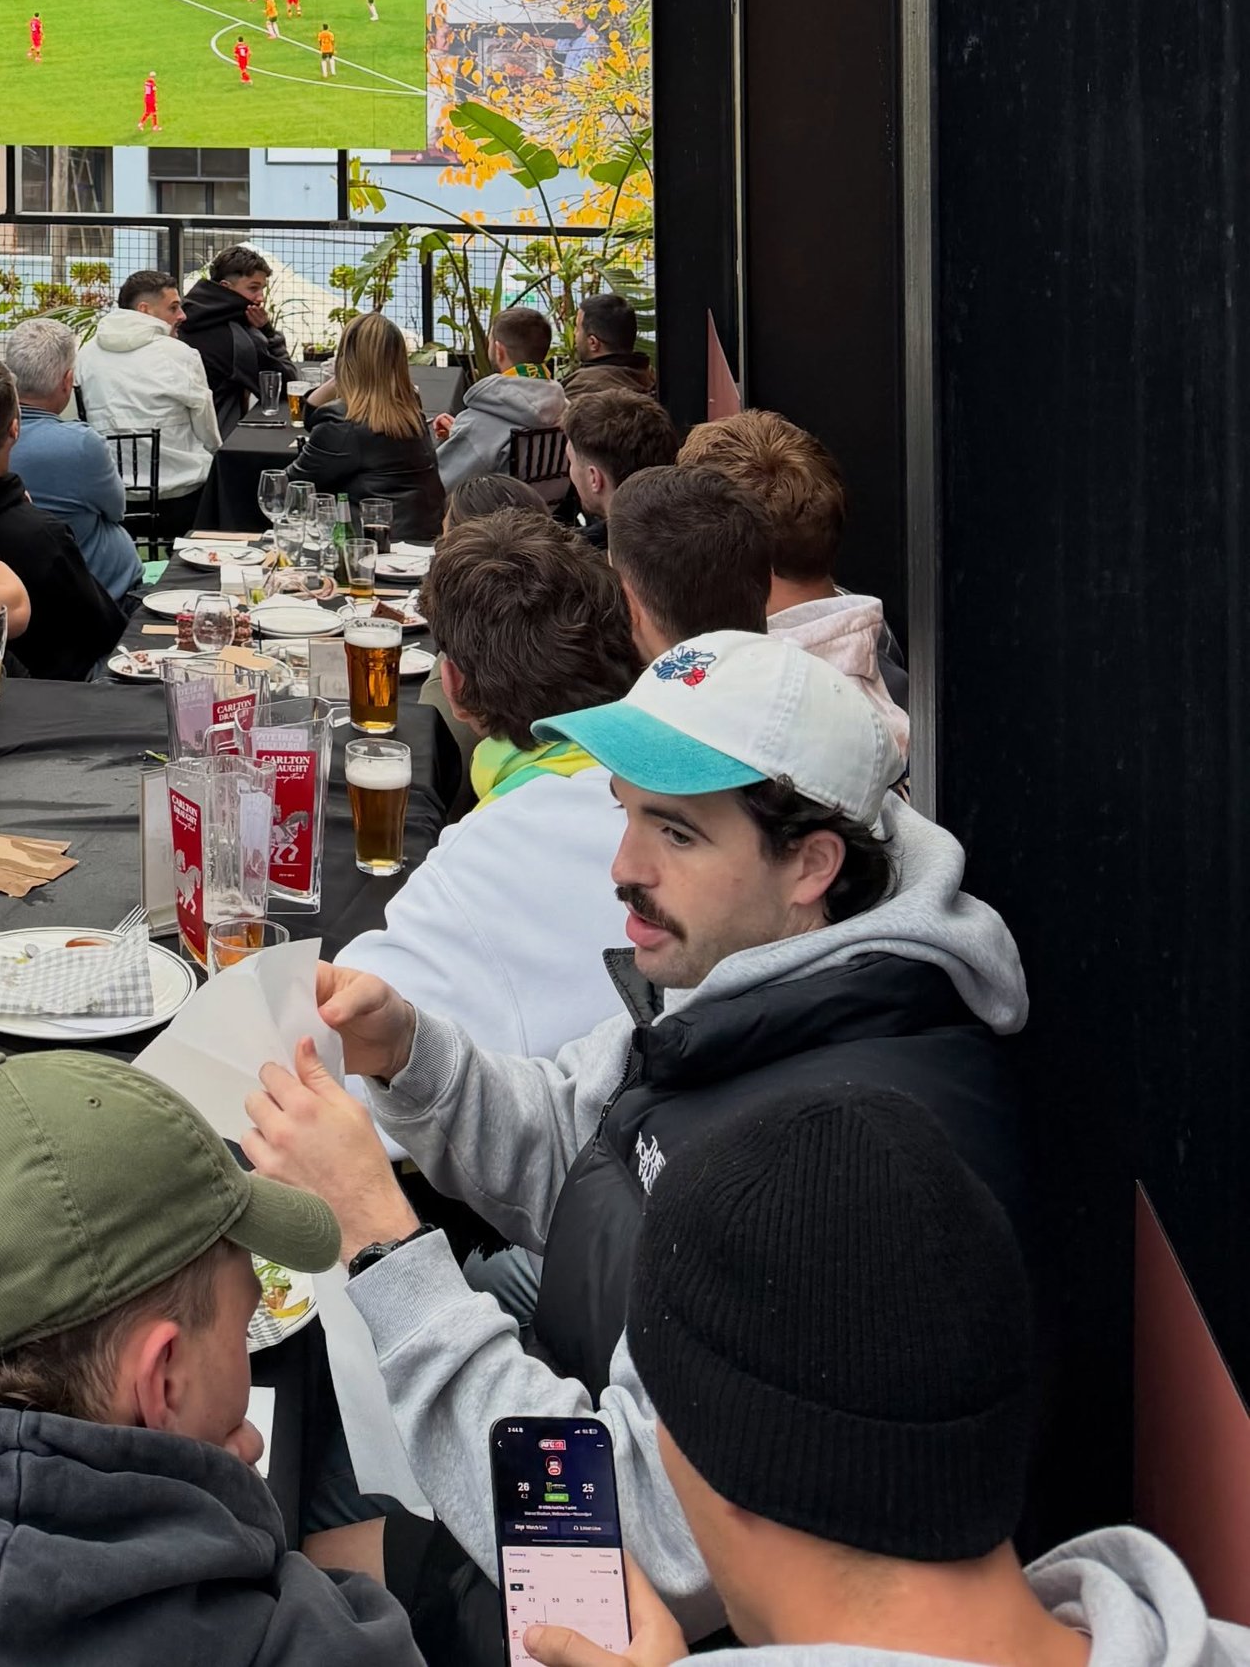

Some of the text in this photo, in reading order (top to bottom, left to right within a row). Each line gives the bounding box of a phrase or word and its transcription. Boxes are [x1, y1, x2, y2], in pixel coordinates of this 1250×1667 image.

[216, 699, 252, 714] CARLTON
[261, 755, 310, 765] CARLTON
[276, 764, 309, 773] AUGHT
[517, 1482, 530, 1492] 26
[582, 1483, 594, 1493] 25
